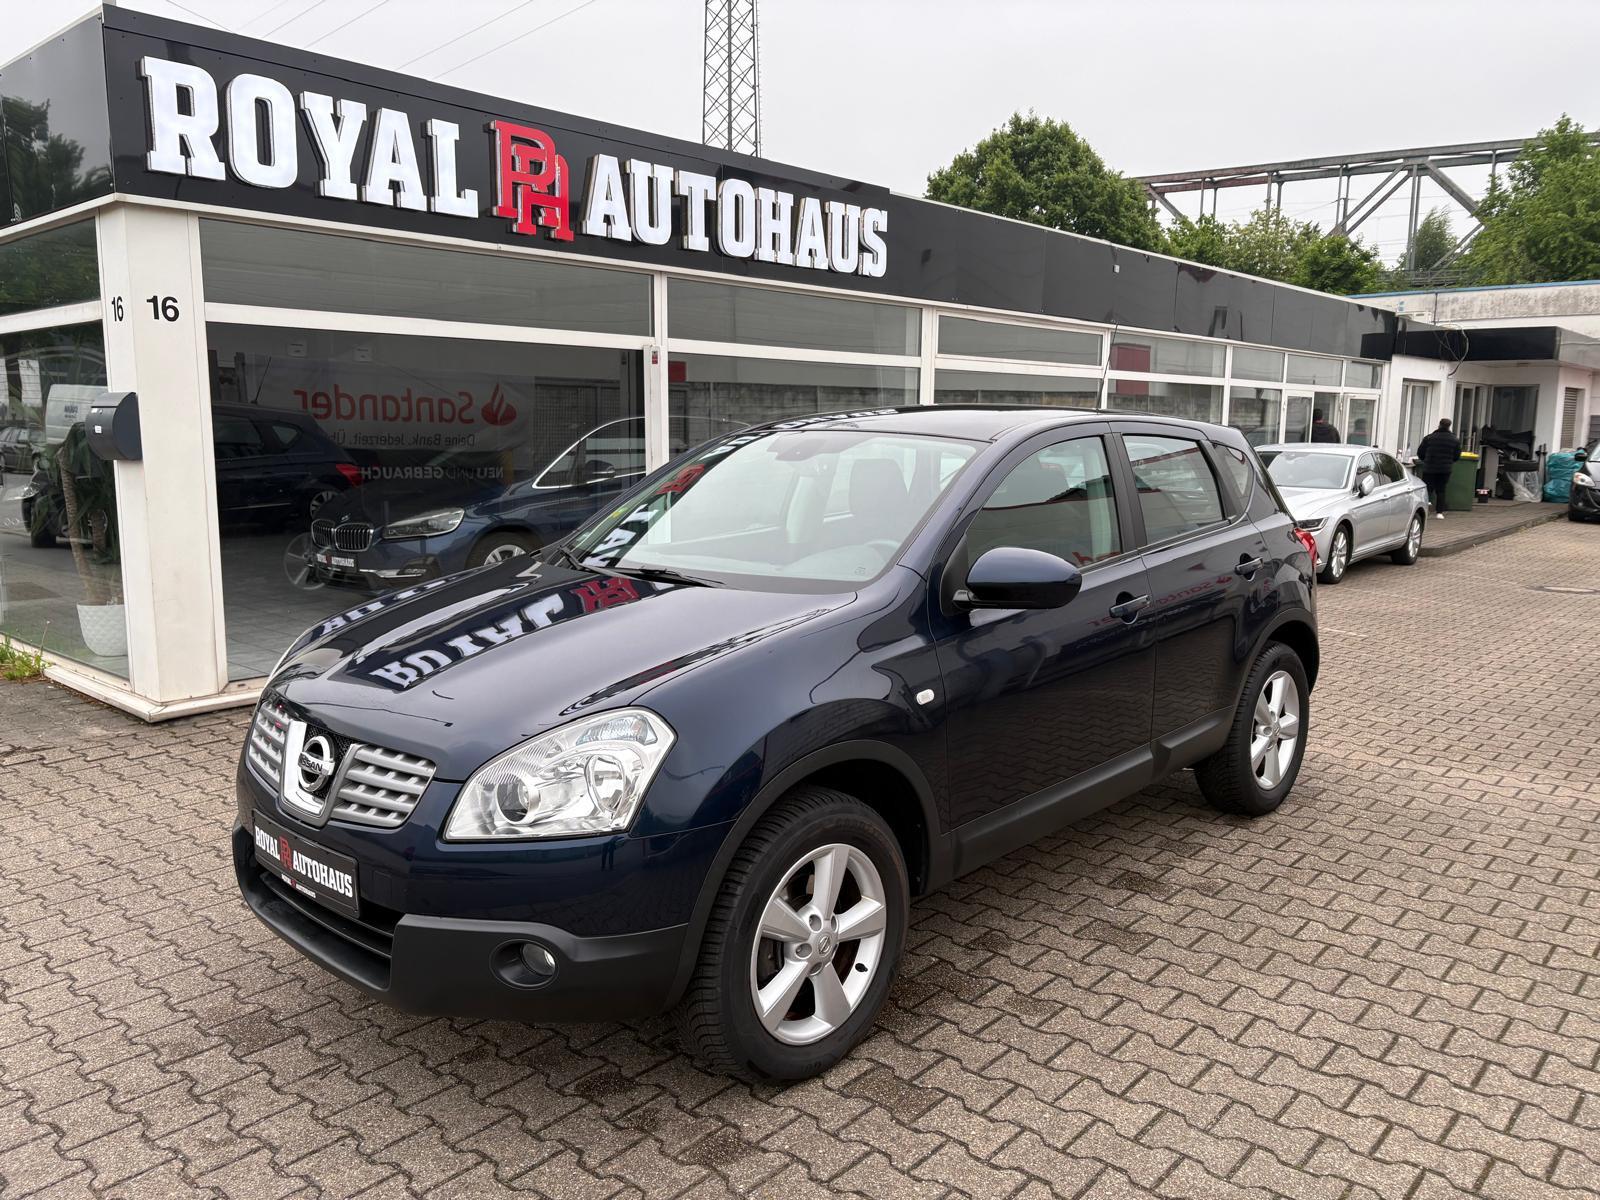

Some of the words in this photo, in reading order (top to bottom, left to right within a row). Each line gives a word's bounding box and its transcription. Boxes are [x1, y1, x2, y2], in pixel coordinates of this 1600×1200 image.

[140, 56, 478, 218] ROYAL
[582, 154, 887, 278] AUTOHAUS
[112, 296, 123, 322] 16
[146, 295, 179, 322] 16
[255, 825, 281, 861] ROYAL
[292, 850, 353, 898] AUTOHAUS
